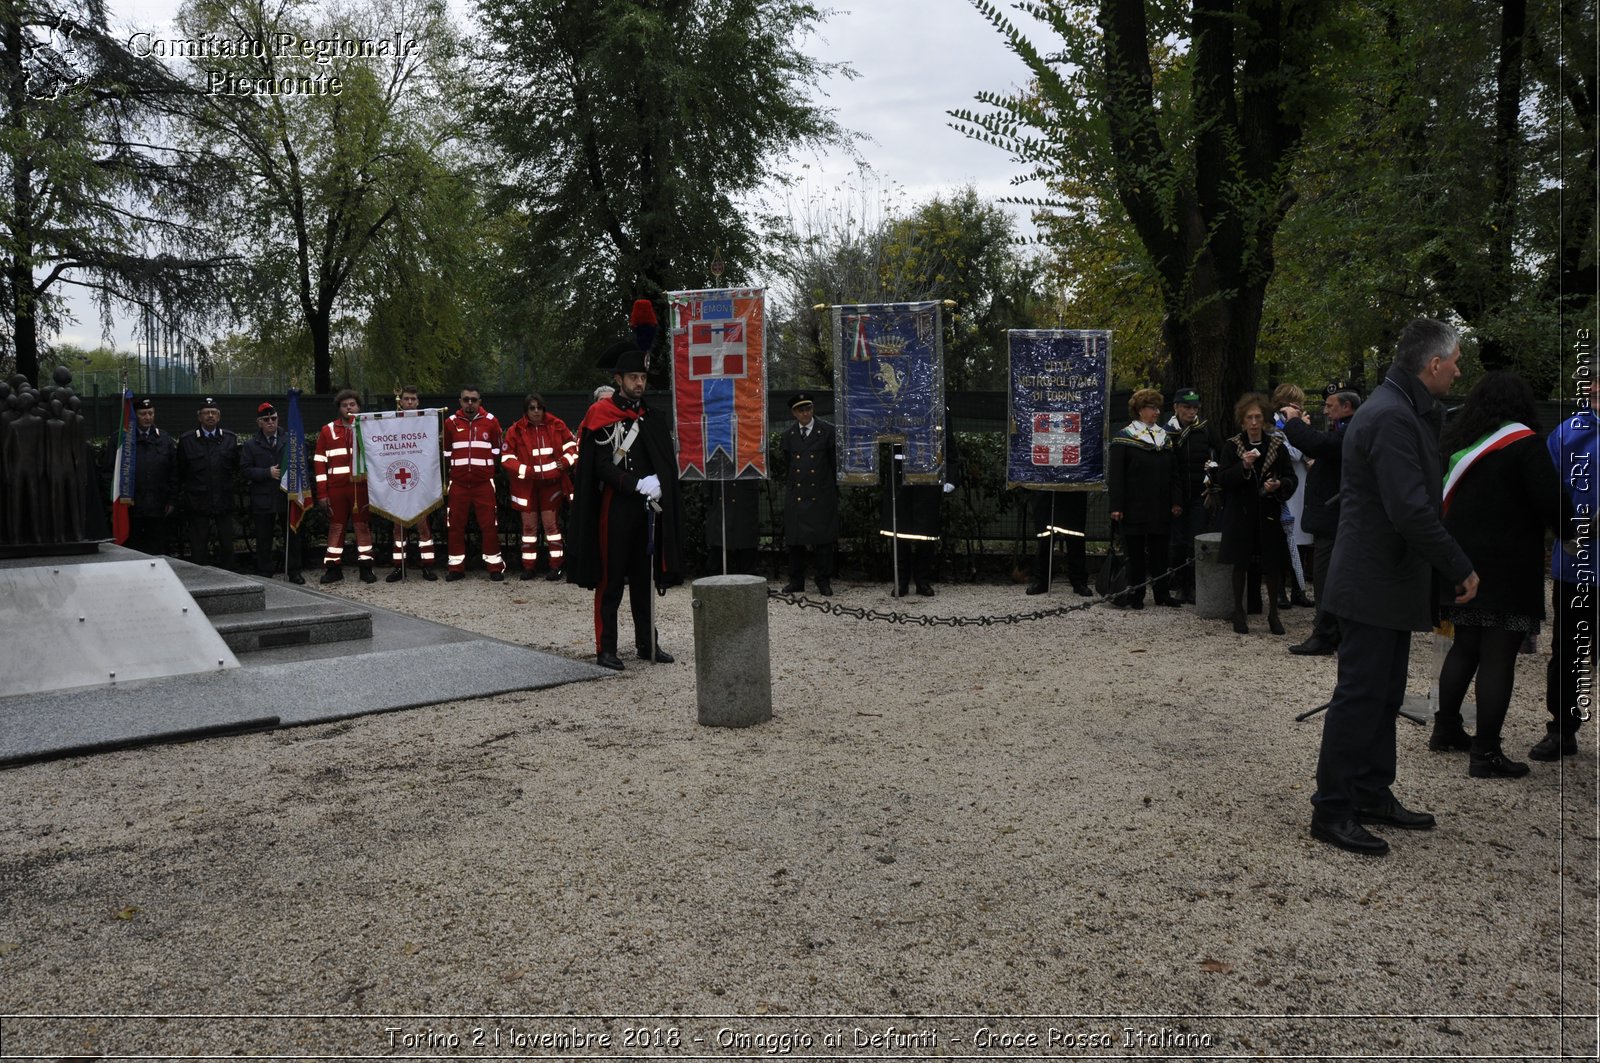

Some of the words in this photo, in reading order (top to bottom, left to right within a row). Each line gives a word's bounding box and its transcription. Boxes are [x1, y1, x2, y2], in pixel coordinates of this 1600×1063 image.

[696, 303, 738, 316] PEMONTE
[372, 434, 398, 442] CROCE
[383, 442, 417, 450] ITALIANA
